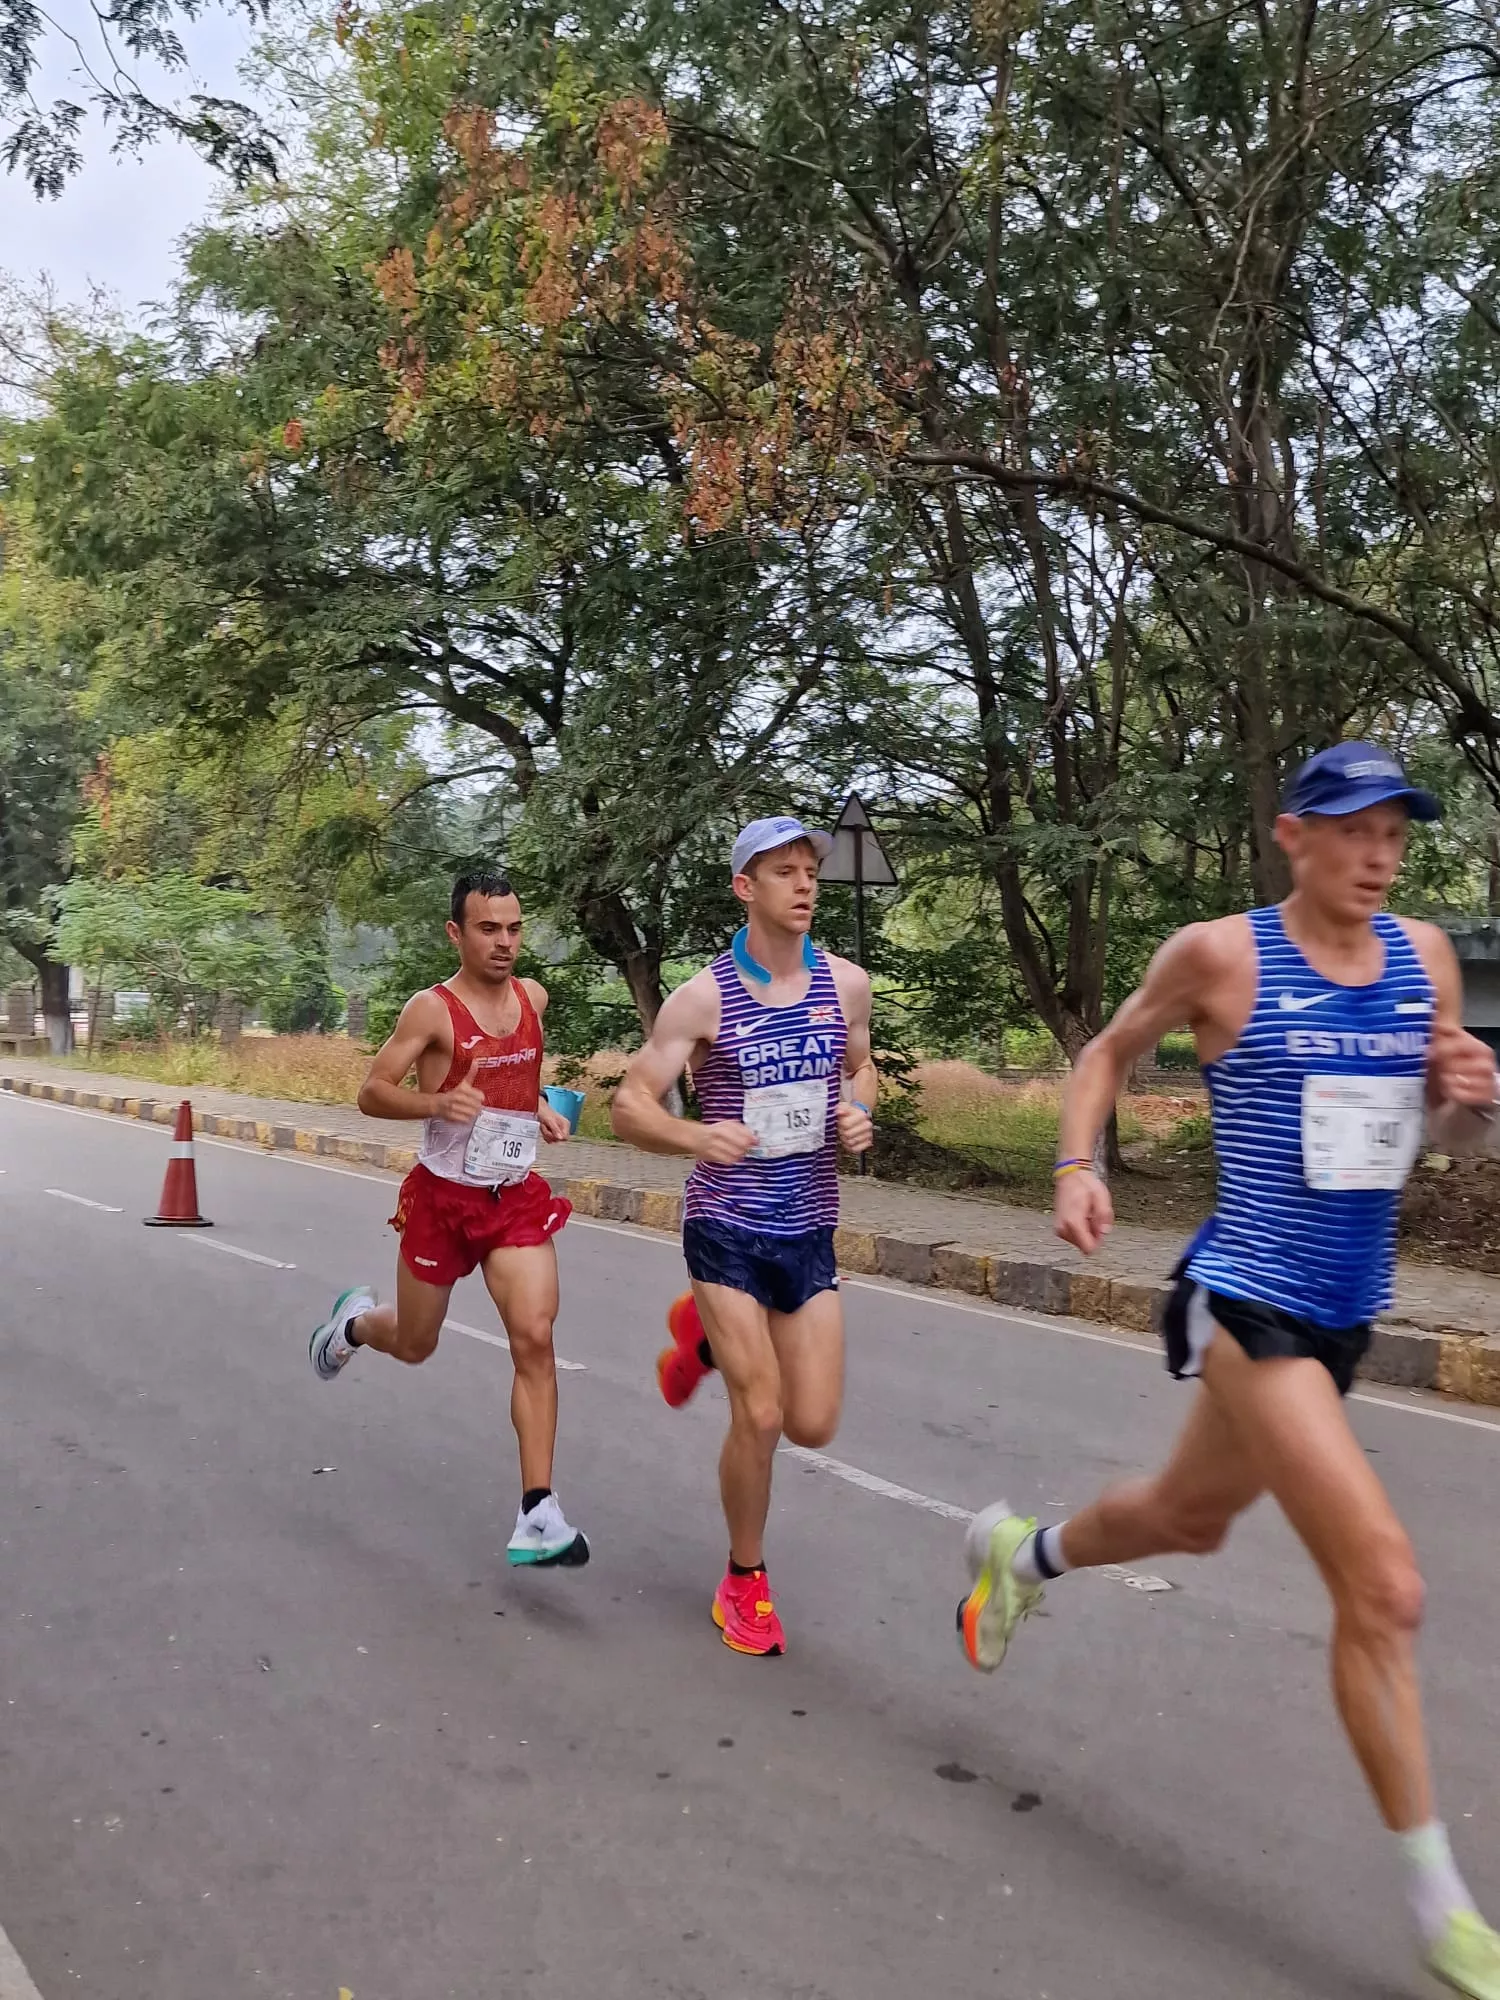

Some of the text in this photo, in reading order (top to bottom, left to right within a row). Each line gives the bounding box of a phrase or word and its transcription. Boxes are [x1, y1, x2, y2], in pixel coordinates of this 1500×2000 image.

[738, 1035, 835, 1067] GREAT
[742, 1057, 836, 1087] BRITAIN
[784, 1108, 811, 1129] 153
[502, 1140, 522, 1159] 136
